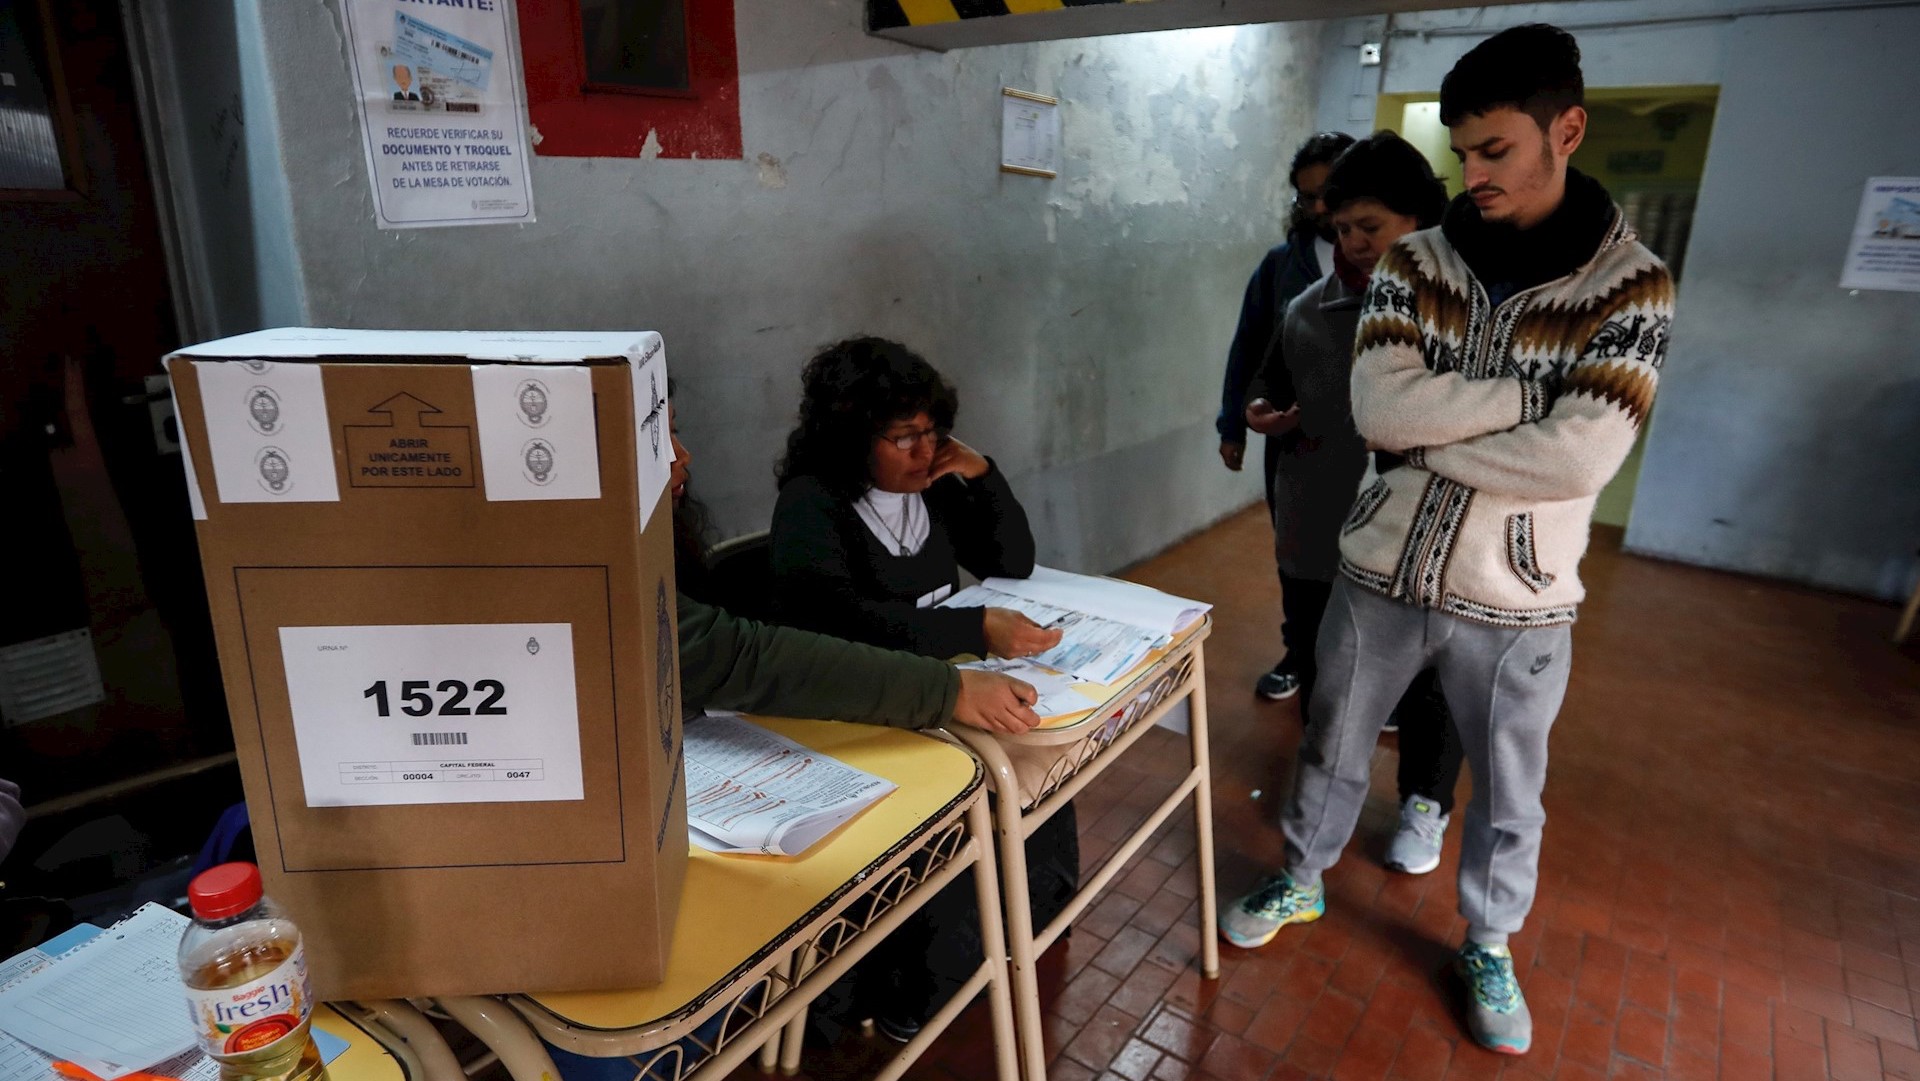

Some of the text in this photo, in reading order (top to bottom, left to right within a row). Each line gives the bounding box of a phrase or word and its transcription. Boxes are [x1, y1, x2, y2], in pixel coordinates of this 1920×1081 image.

[387, 127, 503, 140] RECUERDE VERIFICAR SU
[382, 144, 512, 156] DOCUMENTO Y TROQUEL
[402, 161, 500, 172] ANTES DE RETIRARSE
[392, 178, 405, 189] DE
[408, 177, 422, 188] LA
[423, 177, 450, 187] MESA
[451, 177, 464, 187] DE
[389, 438, 428, 448] ABRIR
[368, 452, 451, 463] UNICAMENTE
[362, 467, 462, 476] POR ESTE LADO
[363, 679, 508, 717] 1522
[506, 771, 531, 779] 0047
[232, 985, 266, 1002] Baggio
[215, 983, 289, 1022] fresh
